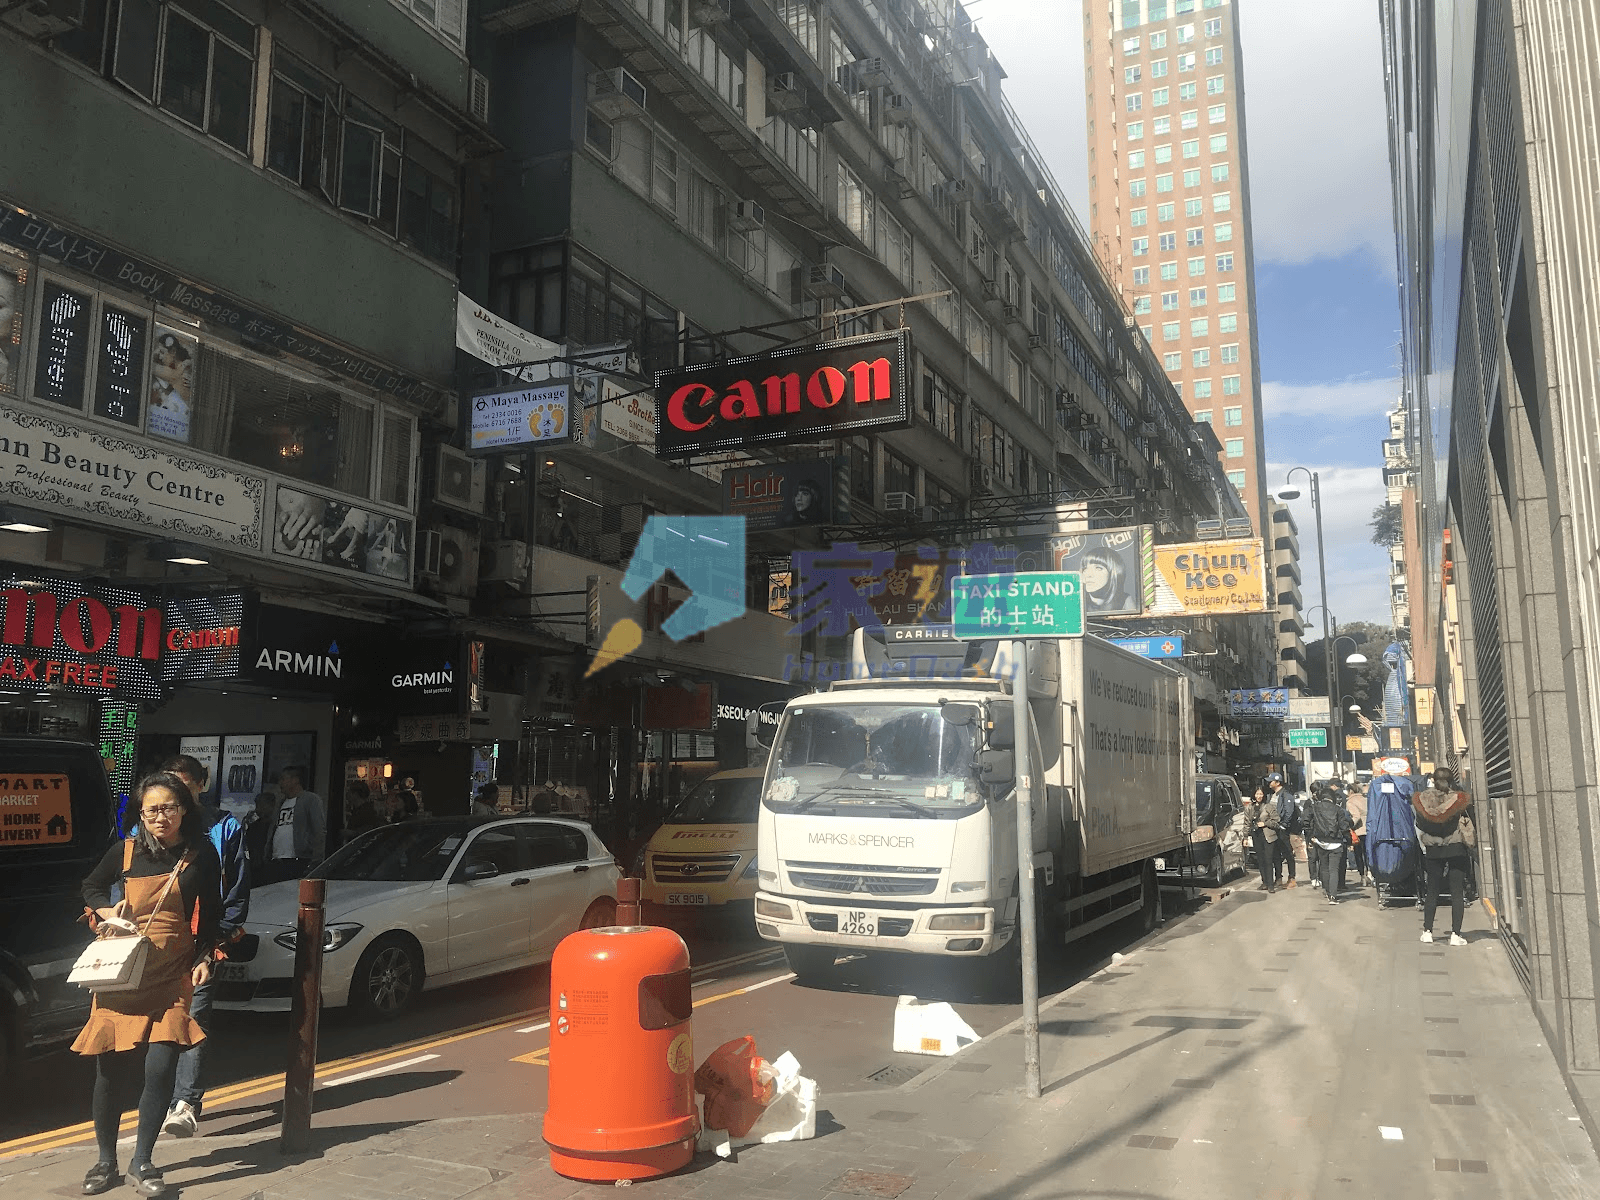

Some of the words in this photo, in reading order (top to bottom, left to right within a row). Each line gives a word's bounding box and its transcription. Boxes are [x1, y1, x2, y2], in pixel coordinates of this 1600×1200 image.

[22, 222, 107, 273] 마사지
[117, 260, 164, 294] Body
[171, 283, 240, 325] Massage
[476, 329, 509, 351] PENINSULA
[492, 397, 519, 409] Maya
[521, 389, 565, 403] Massage
[667, 356, 892, 433] Canon
[507, 426, 521, 437] 1/F
[628, 419, 644, 434] SINCE
[40, 441, 138, 490] Beauty
[146, 471, 227, 508] Centre
[15, 464, 94, 494] Professional
[100, 485, 142, 507] Beauty
[729, 470, 785, 500] Hair
[1052, 534, 1081, 554] Hair
[1103, 530, 1132, 549] Hair
[959, 583, 1000, 600] TAXI
[1007, 581, 1075, 598] STAND
[1186, 573, 1238, 590] Kee
[873, 604, 900, 615] LAU
[907, 602, 947, 613] SHAN
[980, 604, 1055, 629] 的士站
[166, 626, 240, 652] Canon
[255, 647, 342, 679] ARMIN
[45, 661, 118, 690] FREE
[391, 670, 454, 688] GARMIN
[1233, 706, 1260, 717] Scuba
[1261, 705, 1287, 717] Diving
[404, 721, 468, 739] 珍妮曲奇
[181, 745, 209, 754] FORERUNNER
[258, 744, 262, 754] 3
[345, 741, 382, 749] GARMIN
[1090, 722, 1112, 752] That's
[1119, 728, 1133, 761] lorry
[0, 795, 39, 806] ARKET
[3, 813, 41, 826] HOME
[671, 829, 739, 840] PIRELLI
[668, 894, 681, 904] SK
[682, 894, 704, 904] 9015
[849, 910, 866, 922] NP
[841, 921, 875, 936] 4269
